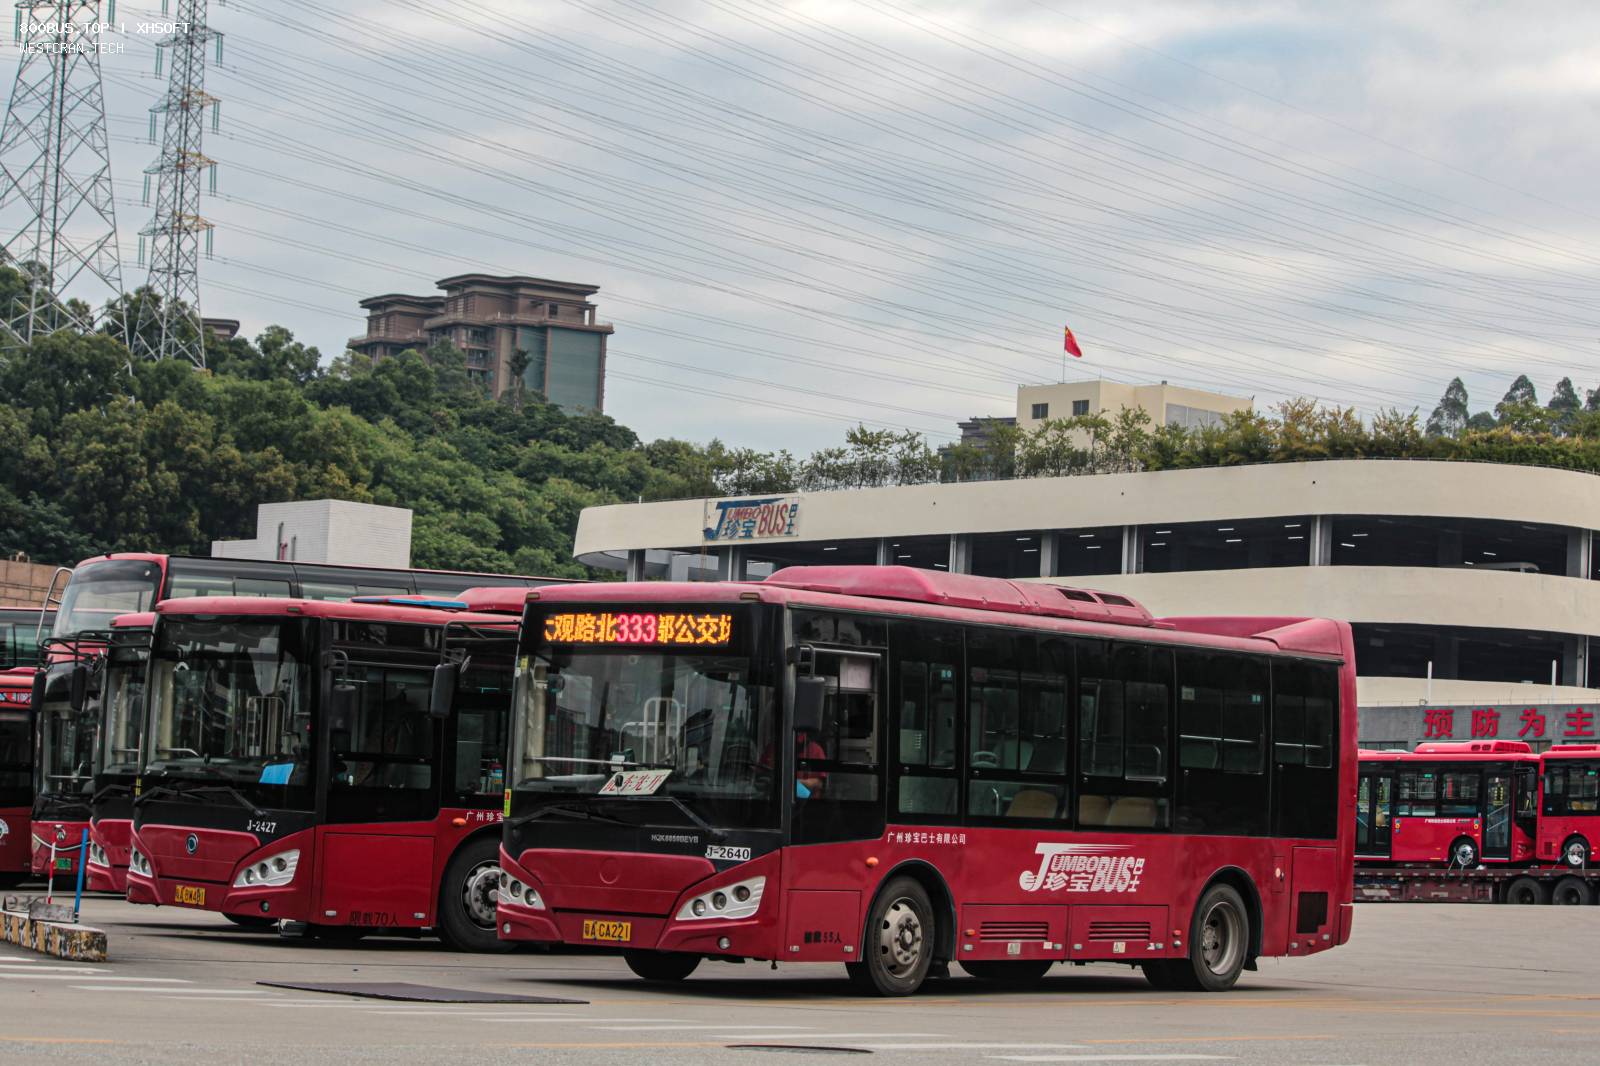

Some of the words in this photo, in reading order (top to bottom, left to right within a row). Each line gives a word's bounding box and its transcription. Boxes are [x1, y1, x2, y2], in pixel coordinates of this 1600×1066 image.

[616, 614, 656, 642] 333
[1423, 707, 1595, 738] 预防为主
[247, 819, 277, 834] J-2427
[887, 831, 966, 845] 广州珍宝巴士有限公司
[707, 846, 750, 860] J-2640
[1042, 871, 1093, 892] 珍宝
[1127, 858, 1145, 892] 巴士
